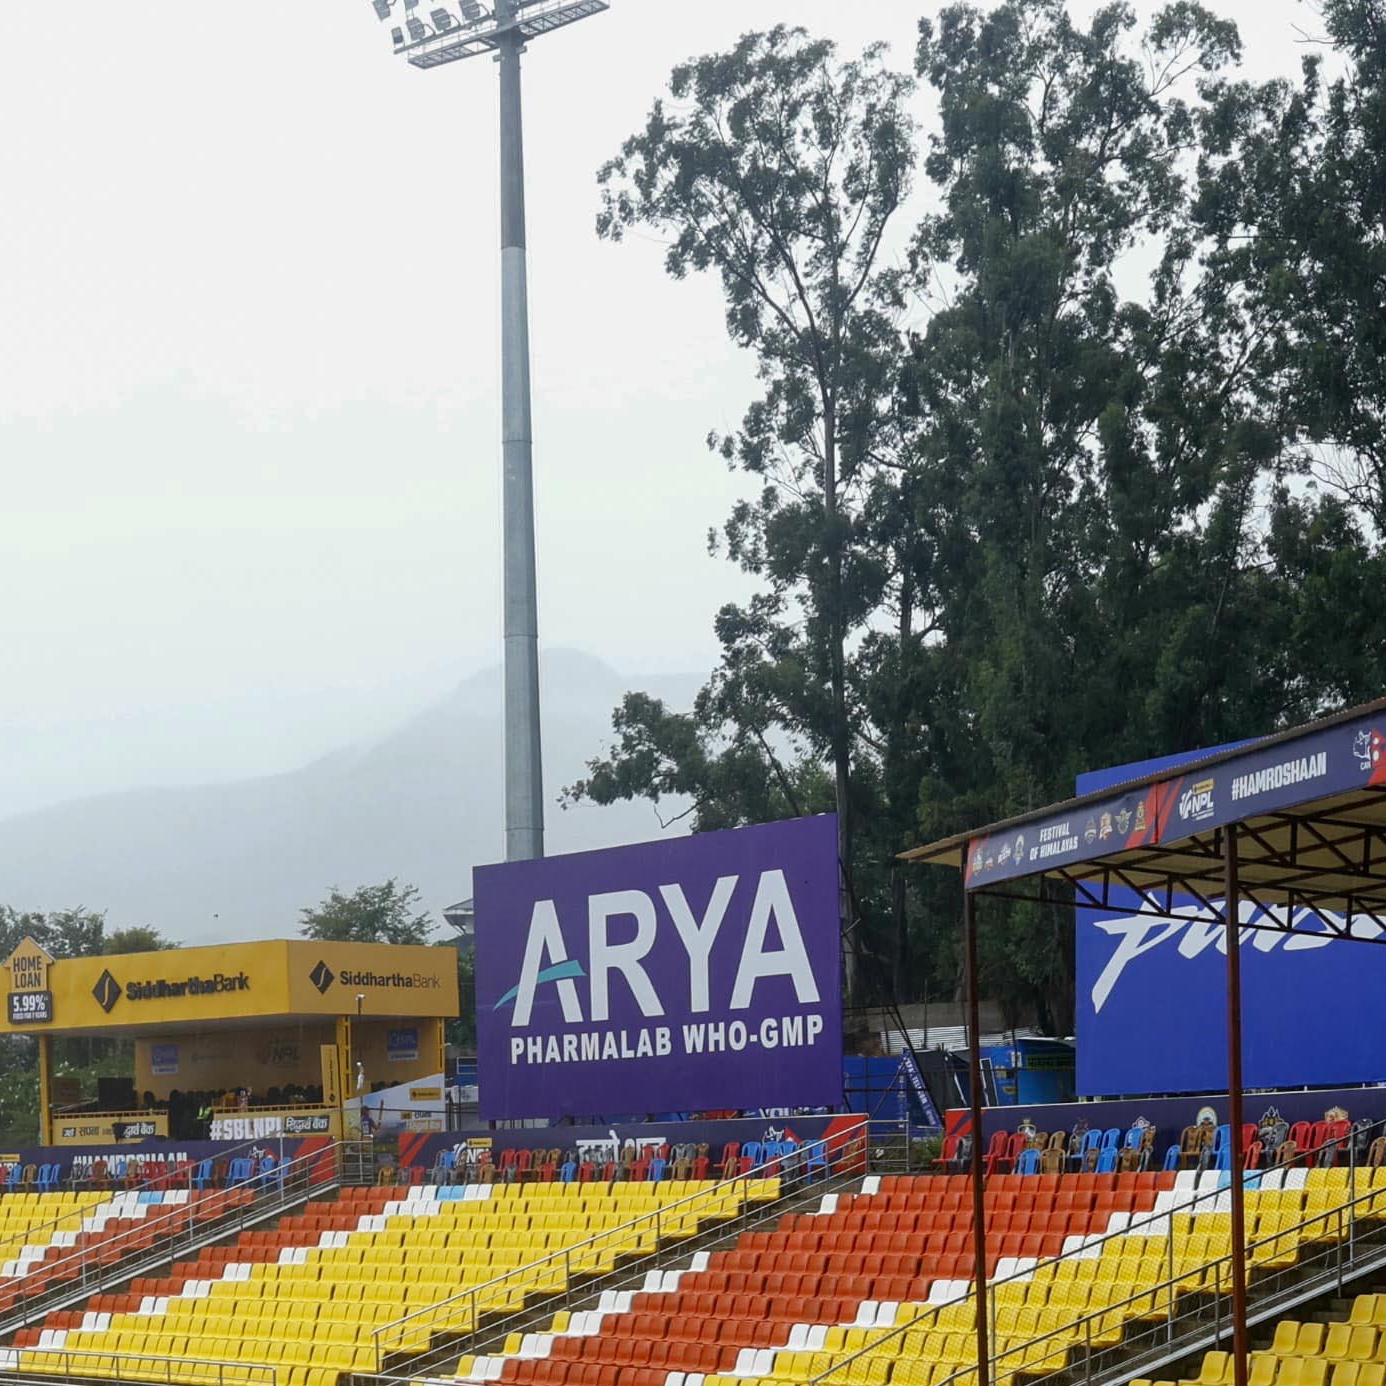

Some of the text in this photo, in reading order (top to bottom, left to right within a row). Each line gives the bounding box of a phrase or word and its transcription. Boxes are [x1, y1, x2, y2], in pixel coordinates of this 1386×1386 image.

[1232, 751, 1327, 800] #HAMROSHAAN
[1191, 791, 1214, 814] NPL
[1039, 822, 1070, 843] FESTIVAL
[1029, 836, 1079, 861] OF HIMALAYAS
[511, 869, 821, 1027] ARYA
[13, 955, 42, 972] HOME
[15, 972, 41, 989] LOAN
[126, 972, 250, 1001] SiddharthaBank
[340, 971, 441, 988] SiddharthaBank
[511, 1014, 824, 1064] PHARMALAB WHO-GMP
